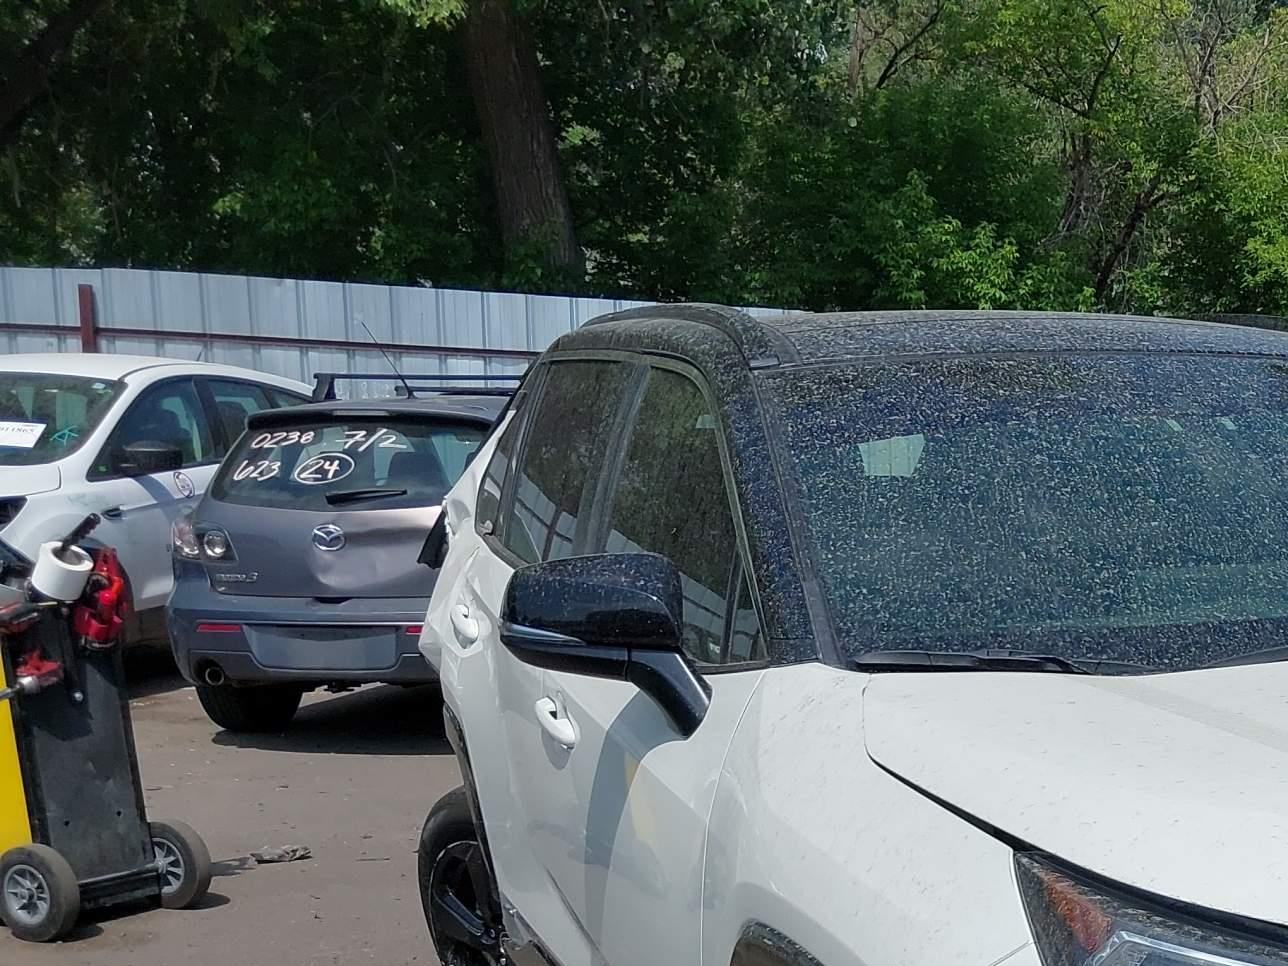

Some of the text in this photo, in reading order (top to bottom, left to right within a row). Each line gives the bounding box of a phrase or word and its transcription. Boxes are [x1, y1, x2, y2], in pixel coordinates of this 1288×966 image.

[251, 429, 407, 451] 0238 7/2
[233, 459, 341, 481] 623 24
